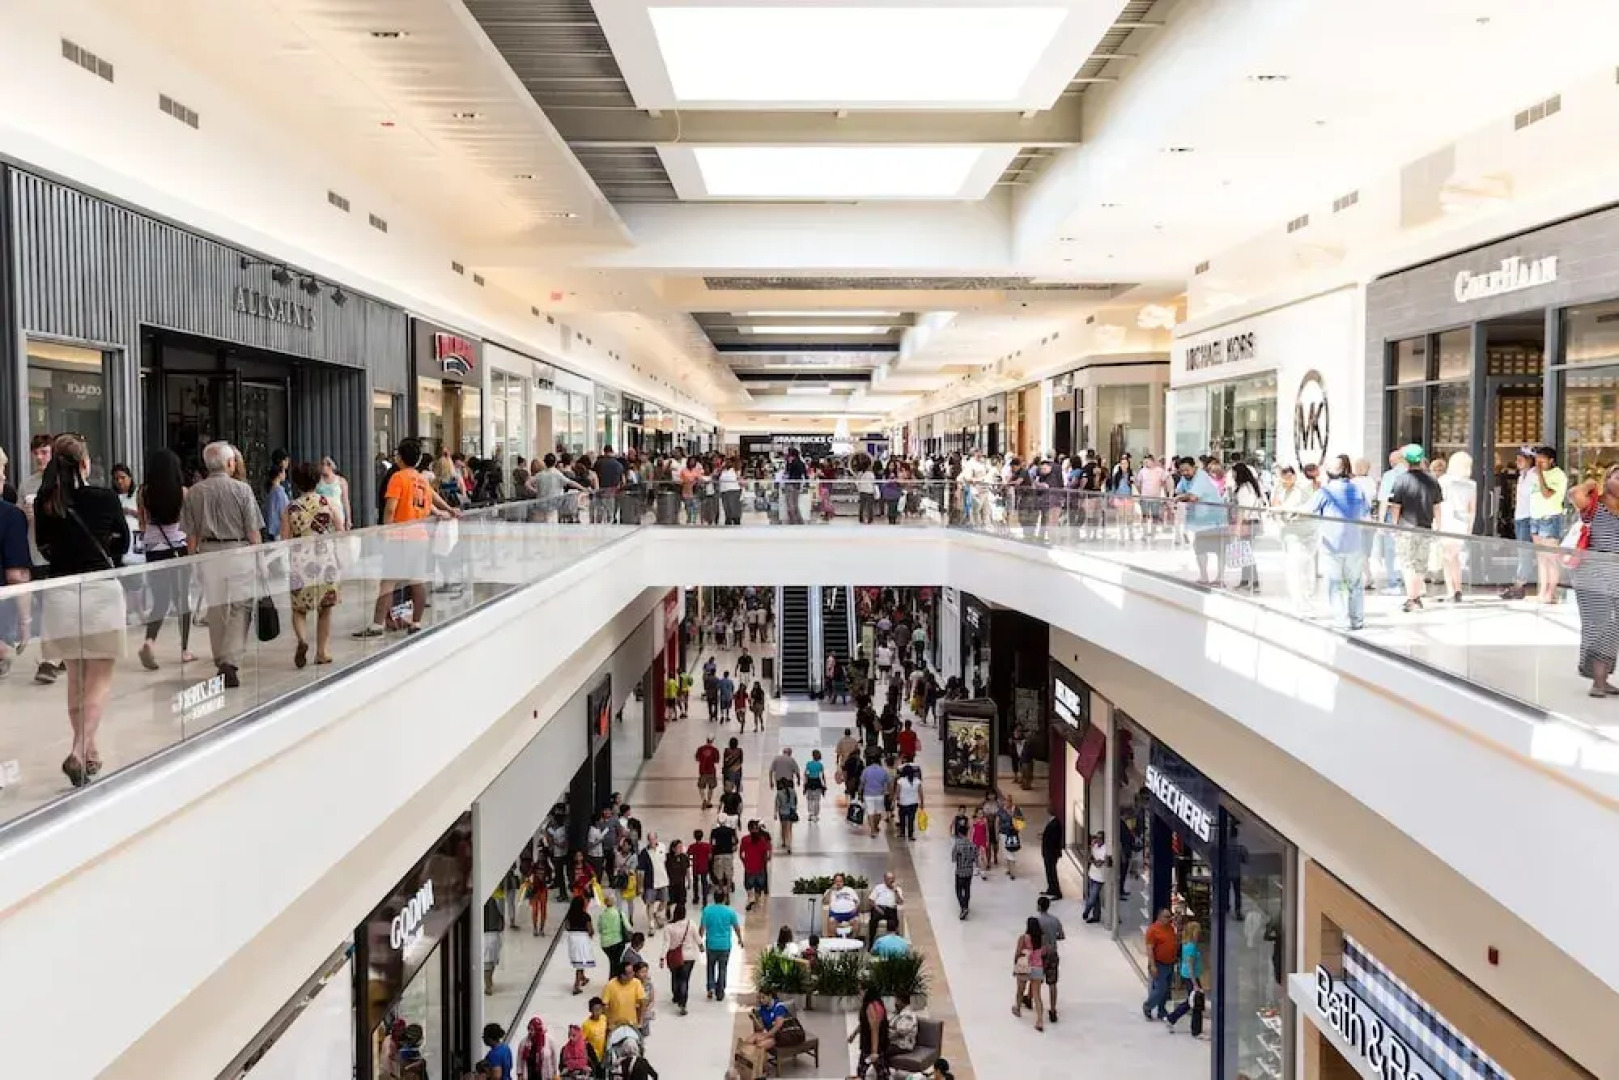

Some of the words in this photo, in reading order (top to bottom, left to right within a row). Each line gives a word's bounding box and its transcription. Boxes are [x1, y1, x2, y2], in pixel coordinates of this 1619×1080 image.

[233, 286, 317, 330] ALLSAINTS
[1186, 339, 1223, 371] MICHAEL
[1226, 331, 1254, 363] KORS
[1298, 402, 1324, 451] MK
[1145, 765, 1211, 843] SKECHERS
[390, 879, 434, 950] GODIVA
[1316, 964, 1366, 1057] Bath
